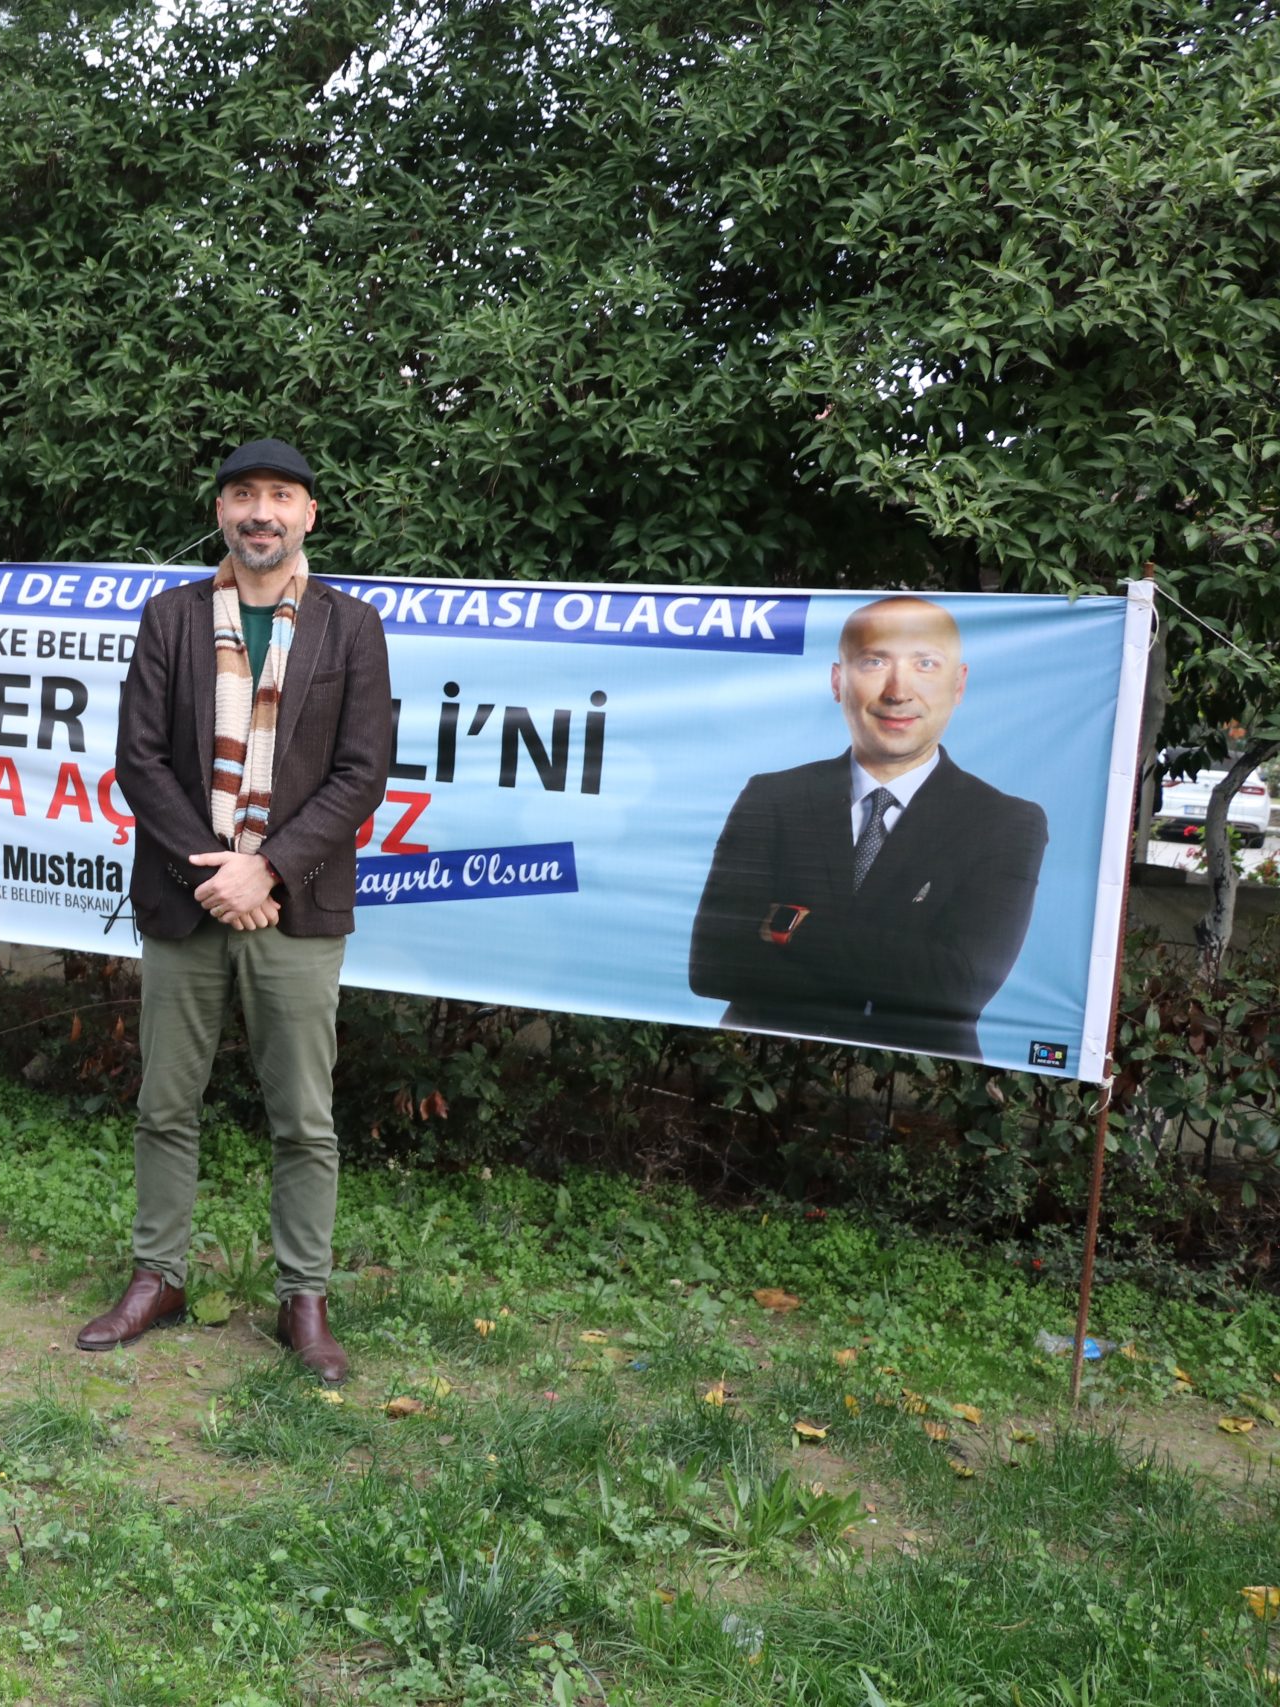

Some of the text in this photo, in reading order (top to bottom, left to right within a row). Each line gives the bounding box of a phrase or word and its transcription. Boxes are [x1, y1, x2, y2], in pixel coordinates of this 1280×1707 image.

[17, 573, 81, 607] DE
[331, 585, 540, 628] OKTASI
[554, 593, 780, 640] OLACAK
[3, 844, 123, 893] Mustafa
[356, 853, 563, 902] ayırlı Olsun
[11, 886, 61, 906] BELEDİYE
[65, 894, 113, 913] BAŞKANI
